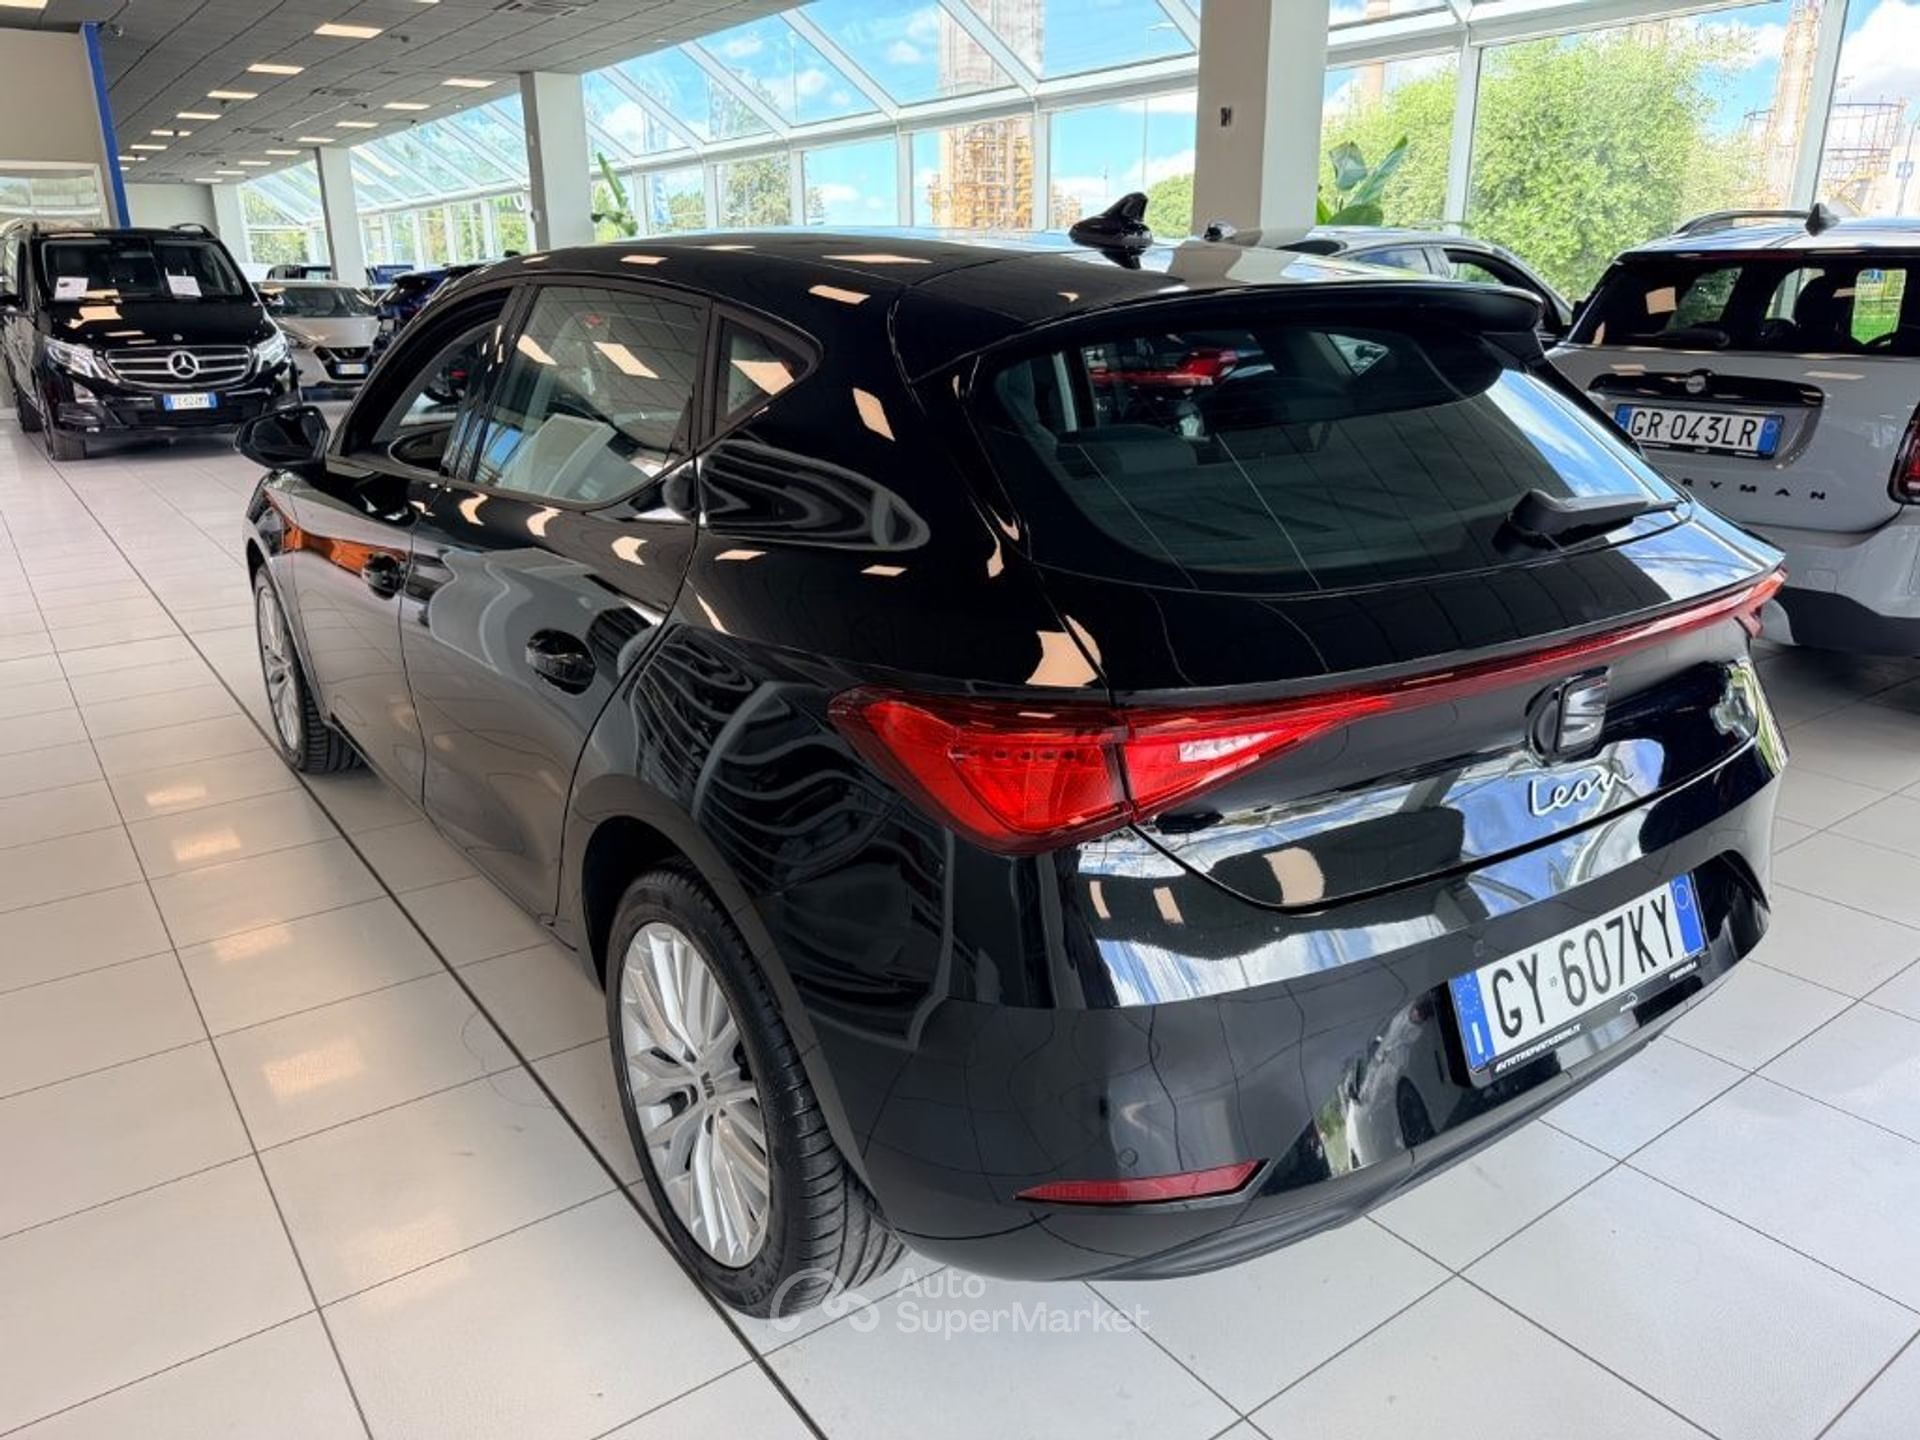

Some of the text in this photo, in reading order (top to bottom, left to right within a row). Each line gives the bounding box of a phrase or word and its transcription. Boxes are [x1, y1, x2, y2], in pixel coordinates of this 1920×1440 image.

[1631, 411, 1757, 447] GR 043LR
[1529, 768, 1633, 817] Leon
[1491, 953, 1545, 1038] GY
[1558, 894, 1676, 1008] 607KY
